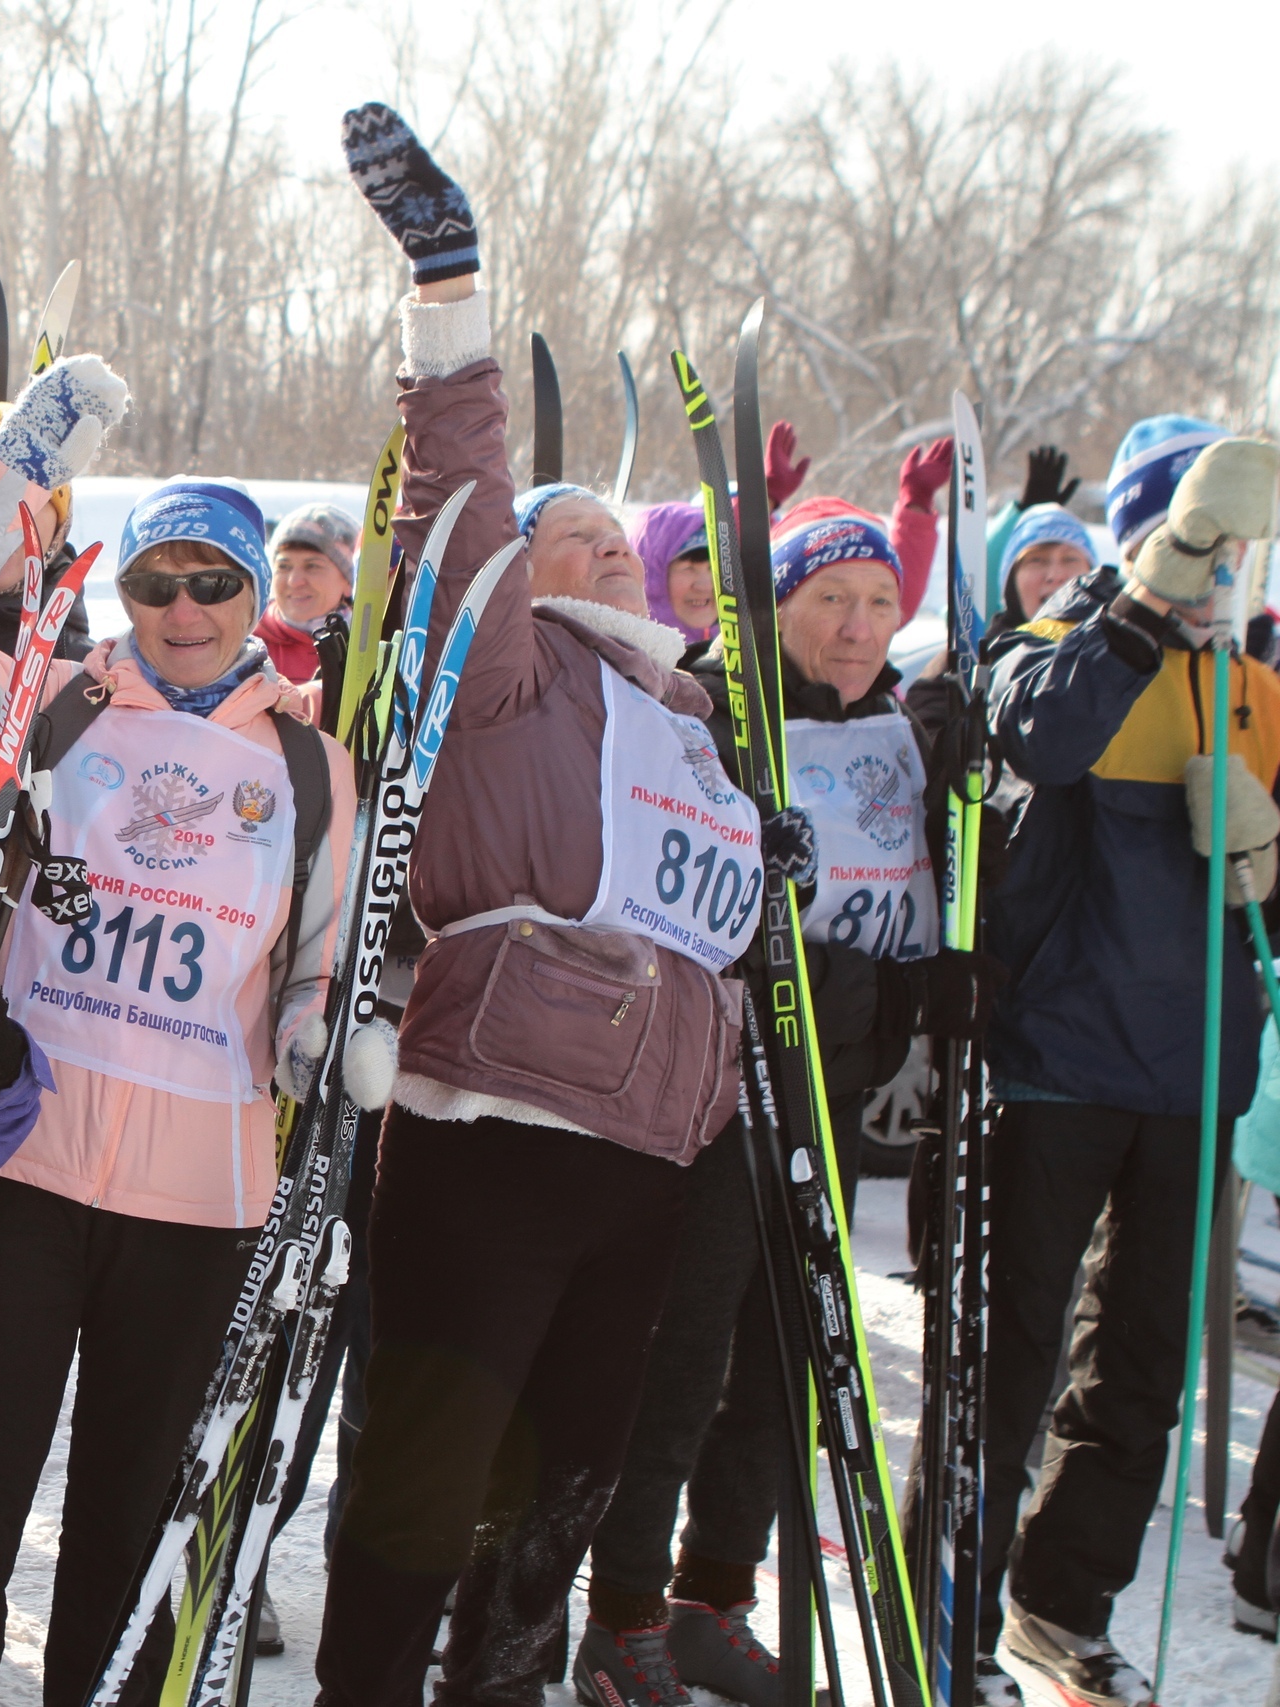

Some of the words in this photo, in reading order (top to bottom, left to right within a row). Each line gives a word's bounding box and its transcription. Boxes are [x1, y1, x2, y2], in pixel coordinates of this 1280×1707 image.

[373, 448, 398, 537] OW
[136, 521, 210, 551] 2019
[718, 521, 735, 593] ACTIVE
[804, 545, 875, 575] 2019
[958, 572, 975, 674] CLASSIC
[718, 593, 750, 749] Larsen
[141, 761, 210, 798] ЛЫЖНЯ
[845, 754, 890, 779] ЛЫЖНЯ
[630, 785, 697, 822] ЛЫЖНЯ
[124, 845, 198, 871] РОССИИ
[174, 829, 216, 847] 2019
[655, 828, 762, 940] 8109
[828, 865, 882, 882] ЛЫЖНЯ
[86, 872, 125, 896] ЖНЯ
[128, 882, 205, 913] РОССИИ
[216, 904, 257, 930] 2019
[621, 896, 692, 947] Республика
[61, 899, 206, 1003] 8113
[29, 981, 121, 1021] Республика
[126, 1004, 229, 1048] Башкортостан
[773, 979, 799, 1049] 3D
[340, 1099, 359, 1141] SK
[225, 1175, 295, 1337] ROSSIGNOL
[825, 1295, 838, 1335] Larsen
